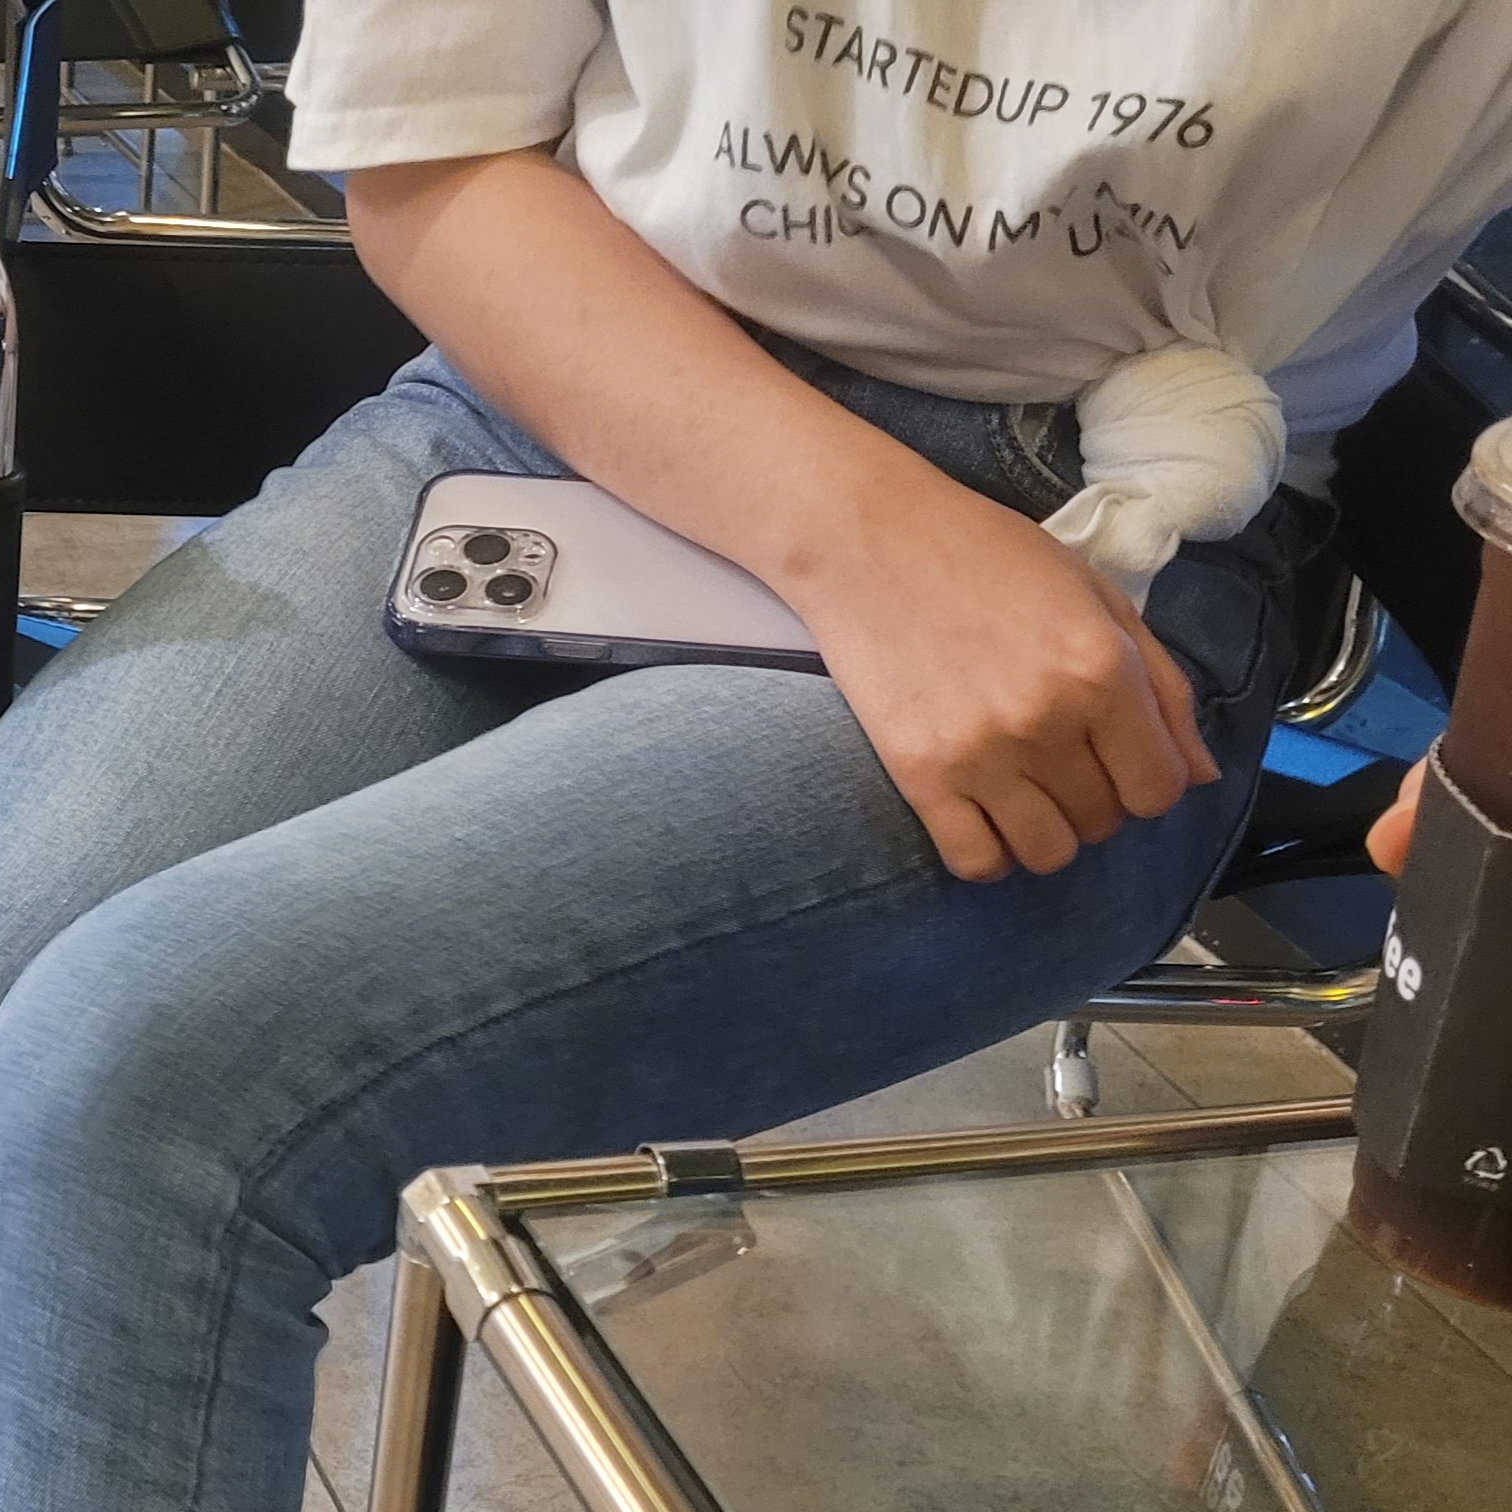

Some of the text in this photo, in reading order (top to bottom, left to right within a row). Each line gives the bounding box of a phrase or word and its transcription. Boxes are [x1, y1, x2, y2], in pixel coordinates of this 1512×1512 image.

[785, 6, 1215, 150] STARTEDUP 1976
[714, 120, 871, 211] ALWYS
[886, 184, 973, 248] ON
[1382, 907, 1422, 1001] ee
